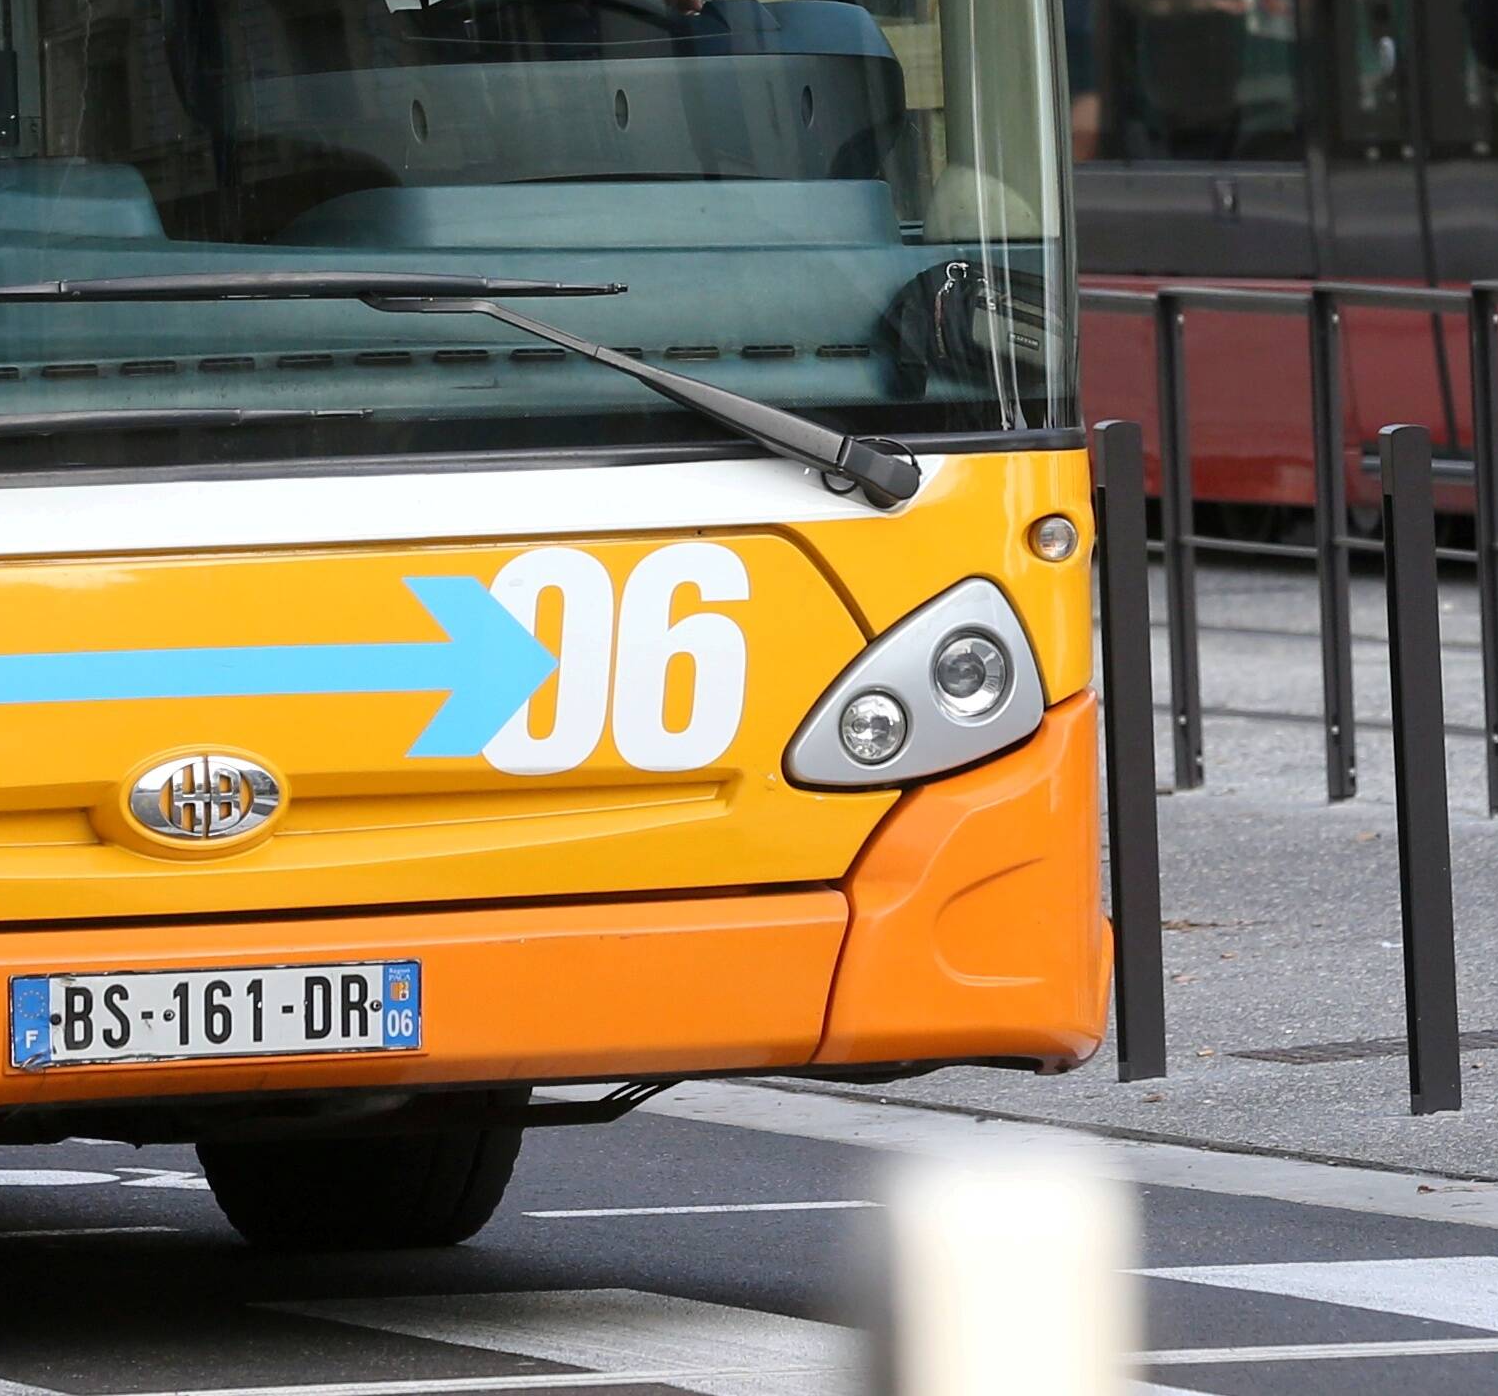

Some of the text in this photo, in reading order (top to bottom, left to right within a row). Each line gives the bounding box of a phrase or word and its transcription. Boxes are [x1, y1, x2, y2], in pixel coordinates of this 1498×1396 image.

[481, 541, 750, 775] 06
[65, 974, 369, 1050] BS-161-DR
[387, 1009, 413, 1038] 06
[25, 1031, 38, 1049] F
